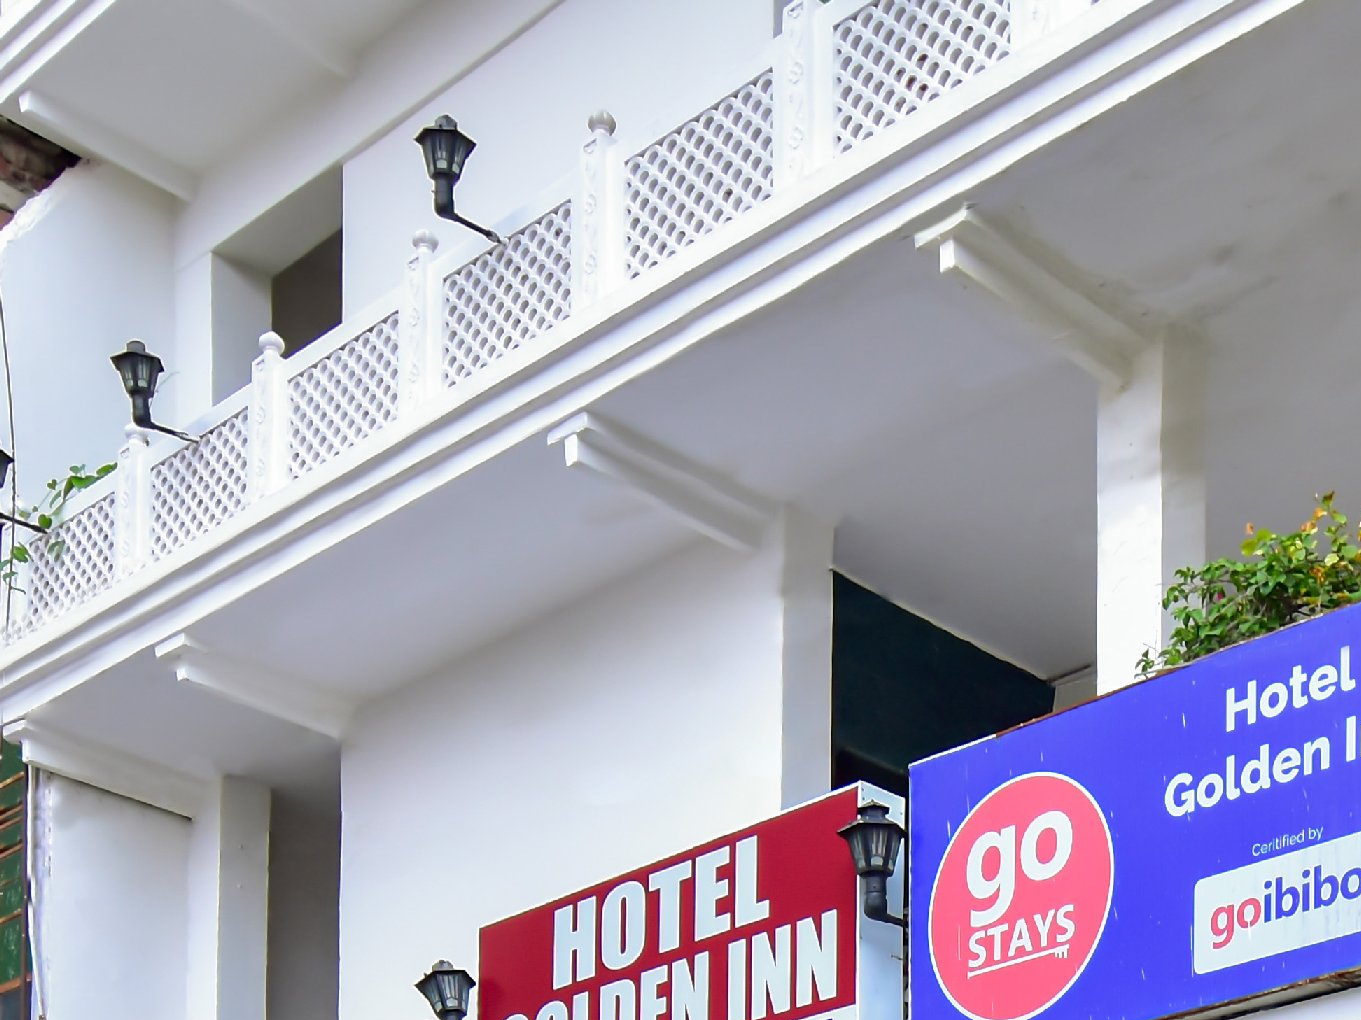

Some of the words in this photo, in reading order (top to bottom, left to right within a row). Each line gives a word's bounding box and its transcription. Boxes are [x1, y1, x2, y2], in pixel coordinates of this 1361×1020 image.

[1226, 645, 1356, 732] Hotel
[1165, 736, 1330, 817] Golden
[965, 810, 1073, 928] go
[1308, 826, 1324, 841] by
[552, 834, 770, 991] HOTEL
[968, 904, 1076, 969] STAYS
